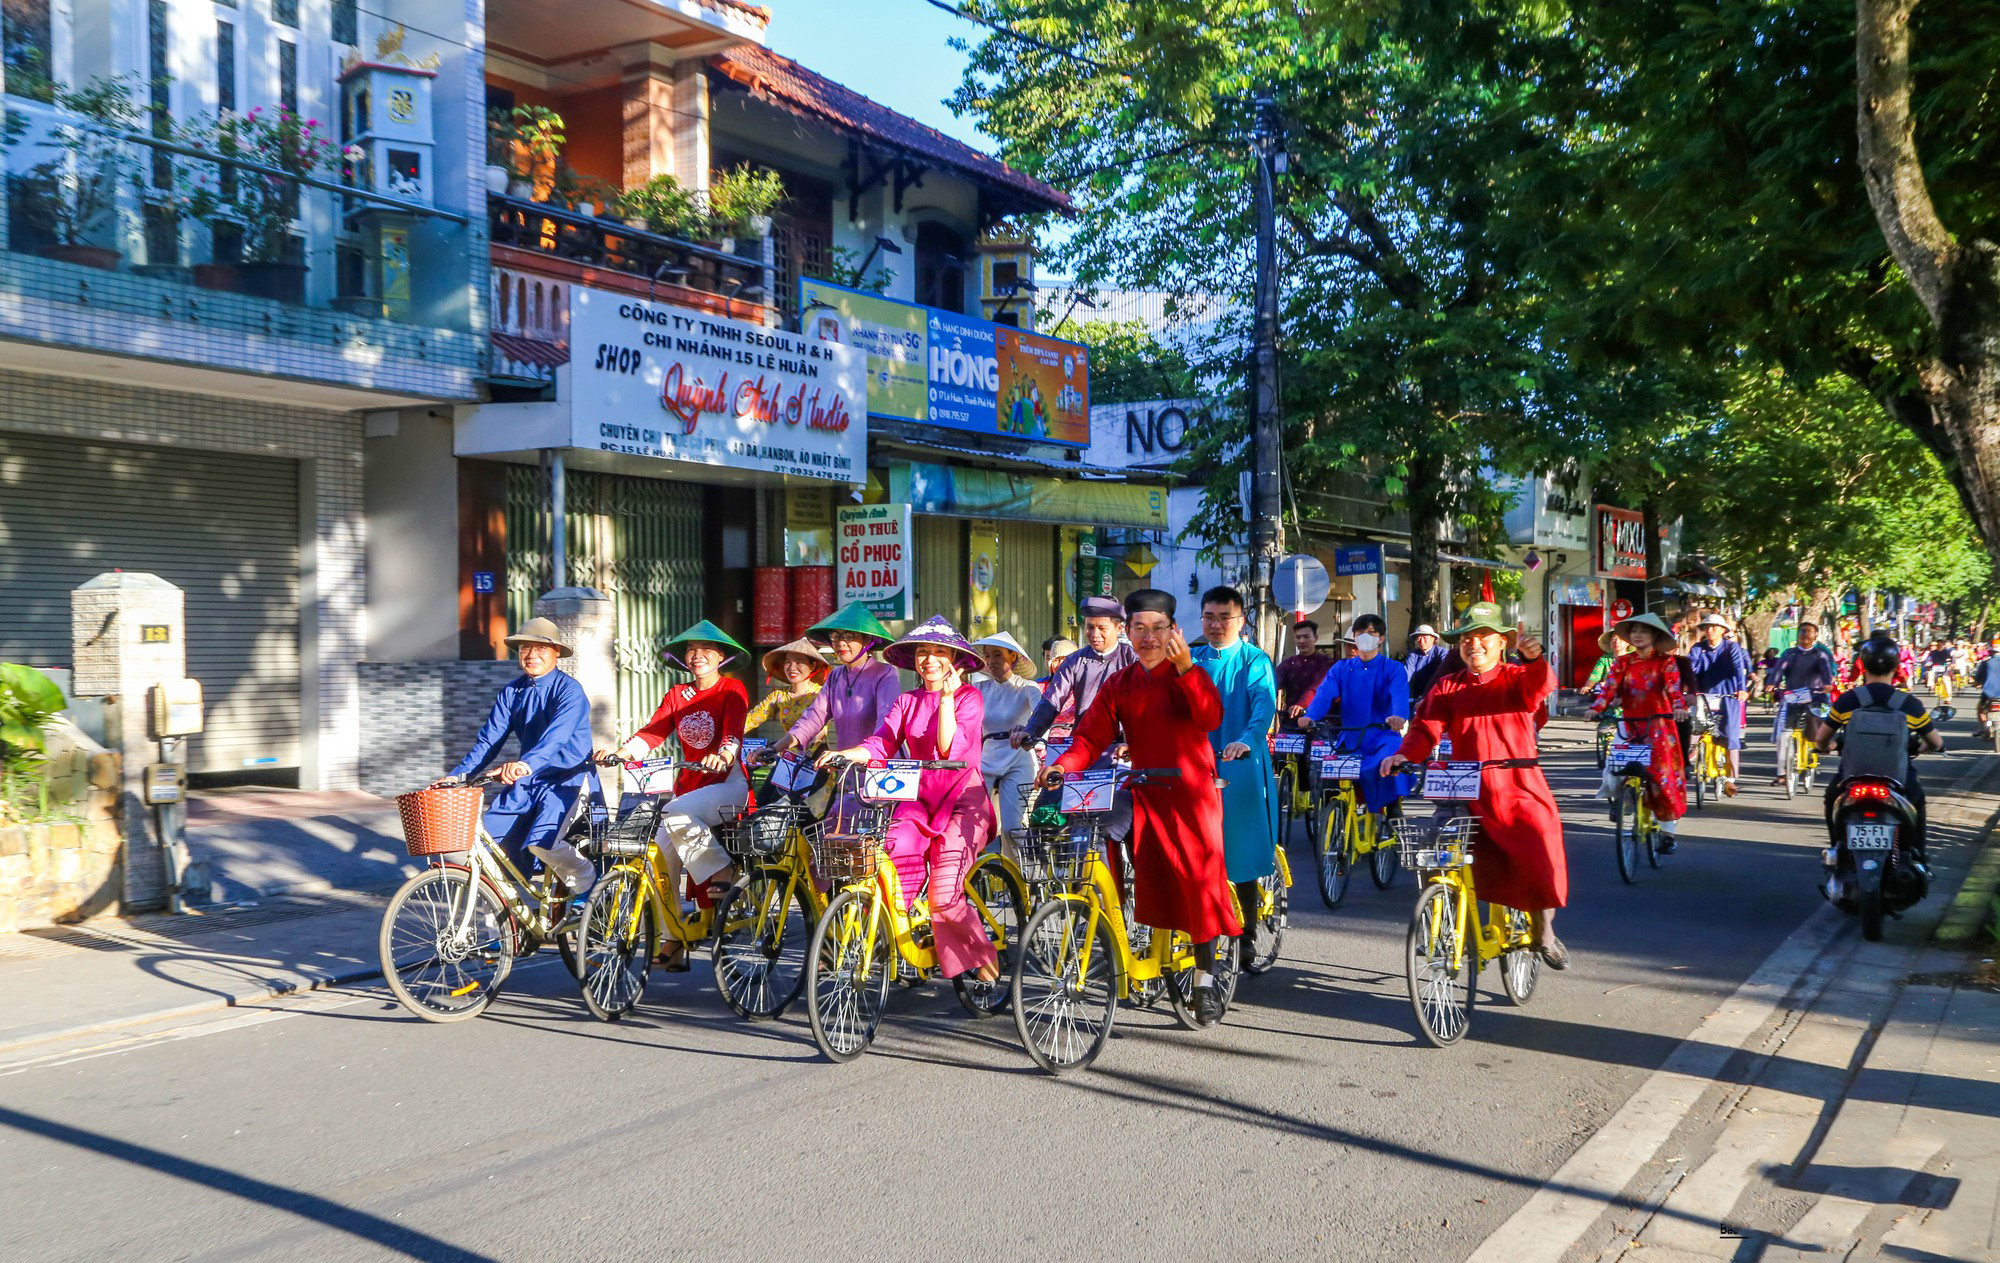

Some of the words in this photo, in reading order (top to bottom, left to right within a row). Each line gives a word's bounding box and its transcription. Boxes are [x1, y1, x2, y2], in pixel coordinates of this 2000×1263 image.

[619, 303, 667, 326] CÔNG
[672, 314, 694, 331] TY
[699, 320, 741, 342] TNHH
[745, 332, 793, 354] SEOUL
[796, 343, 806, 356] H
[809, 345, 820, 358] &
[823, 349, 833, 361] H
[595, 342, 641, 375] SHOP
[644, 331, 671, 350] CHI
[676, 339, 732, 361] NHÁNH
[735, 350, 753, 365] 15
[757, 353, 775, 370] LÊ
[778, 359, 818, 378] HUÂN
[929, 335, 1000, 393] HỒNG
[600, 422, 640, 442] CHUYÊN
[621, 443, 634, 453] 15
[789, 467, 815, 478] 0935
[815, 471, 833, 481] 476
[834, 474, 851, 483] 527
[869, 507, 888, 518] Anh
[843, 524, 866, 537] CHO
[868, 519, 899, 536] THUÊ
[1617, 518, 1646, 555] MIXU
[840, 539, 860, 563] CỔ
[475, 575, 492, 589] 15
[845, 566, 867, 588] ÁO
[871, 562, 898, 587] DÀI
[145, 626, 168, 641] 13
[1855, 826, 1884, 836] 75-F1
[1851, 837, 1889, 848] 654.93
